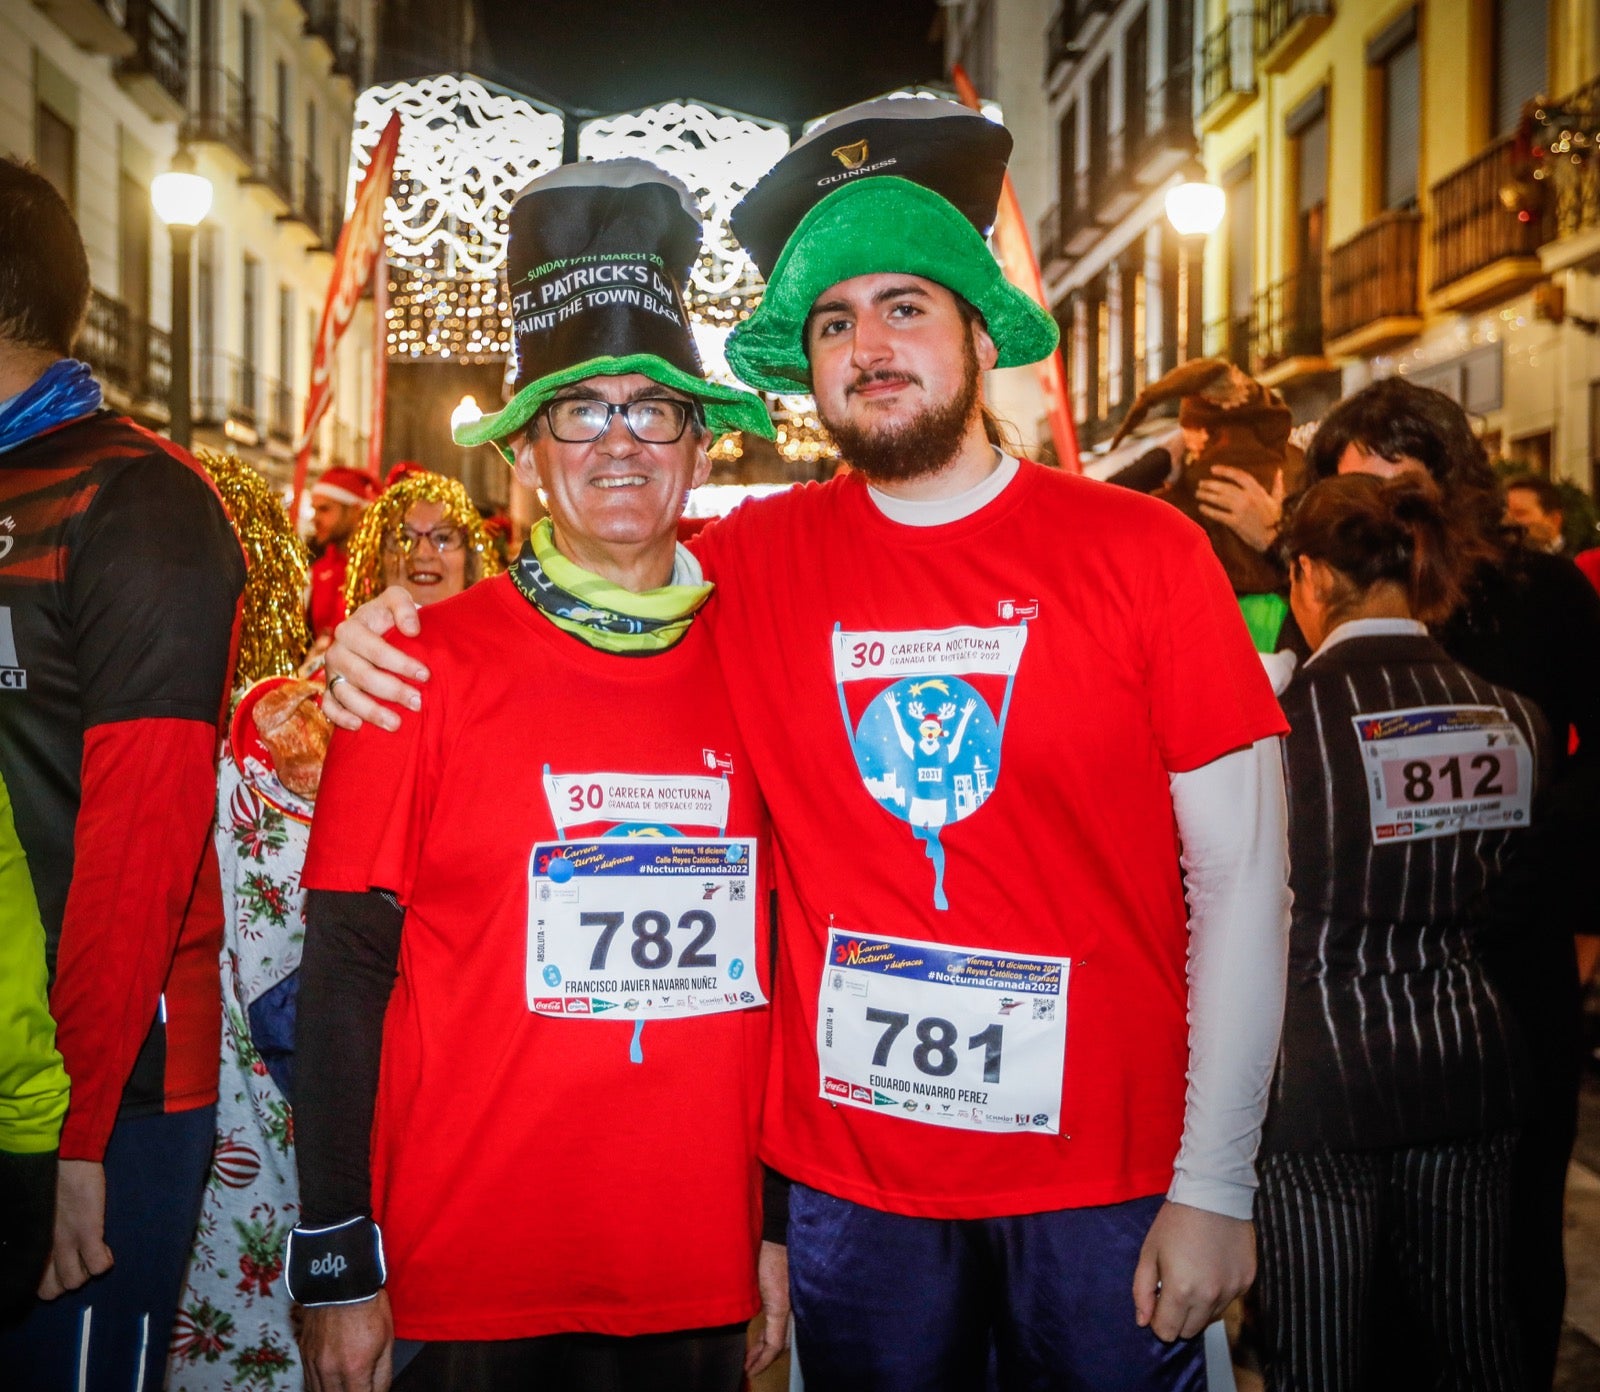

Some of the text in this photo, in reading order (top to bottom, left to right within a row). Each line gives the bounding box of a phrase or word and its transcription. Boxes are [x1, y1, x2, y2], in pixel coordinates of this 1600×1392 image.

[817, 157, 897, 186] GUINNESS
[527, 258, 567, 282] SUNDAY
[600, 253, 646, 262] MARCH
[650, 253, 664, 268] 20
[512, 291, 536, 316] ST.
[541, 265, 648, 305] PATRICK'S
[517, 312, 556, 339] AINT
[558, 298, 583, 322] THE
[585, 289, 640, 308] TOWN
[851, 637, 1000, 668] 30 CARRERA NOCTURNA
[889, 655, 925, 666] GRANADA
[928, 655, 937, 663] DE
[980, 651, 1001, 661] 2022
[1402, 753, 1504, 803] 812
[567, 783, 711, 812] 30 CARRERA NOCTURNA
[608, 800, 640, 810] GRANADA
[642, 801, 651, 810] DE
[695, 802, 713, 812] 2022
[563, 844, 600, 859] Carrera
[655, 856, 671, 864] Calle
[672, 856, 691, 865] Reyes
[692, 855, 719, 864] Católicos
[671, 846, 695, 856] Viernes,
[600, 855, 635, 870] disfraces
[639, 864, 748, 874] #NocturnaGranada2022
[537, 931, 545, 963] ABSOLUTA
[579, 909, 717, 970] 782
[836, 940, 890, 963] 30 Carrera
[846, 950, 896, 966] Nocturna
[883, 959, 924, 971] y disfraces
[966, 957, 995, 968] Viernes,
[996, 959, 1005, 968] 16
[1006, 961, 1041, 971] diciembre
[966, 966, 988, 977] Reyes
[989, 968, 1023, 979] Católicos
[1028, 973, 1059, 983] Granada
[565, 975, 718, 993] FRANCISCO JAVIER NAVARRO NUÑEZ
[928, 971, 1059, 993] #NocturnaGranada2022
[865, 1007, 1004, 1084] 781
[869, 1074, 988, 1105] EDUARDO NAVARRO PEREZ
[310, 1252, 348, 1278] edp
